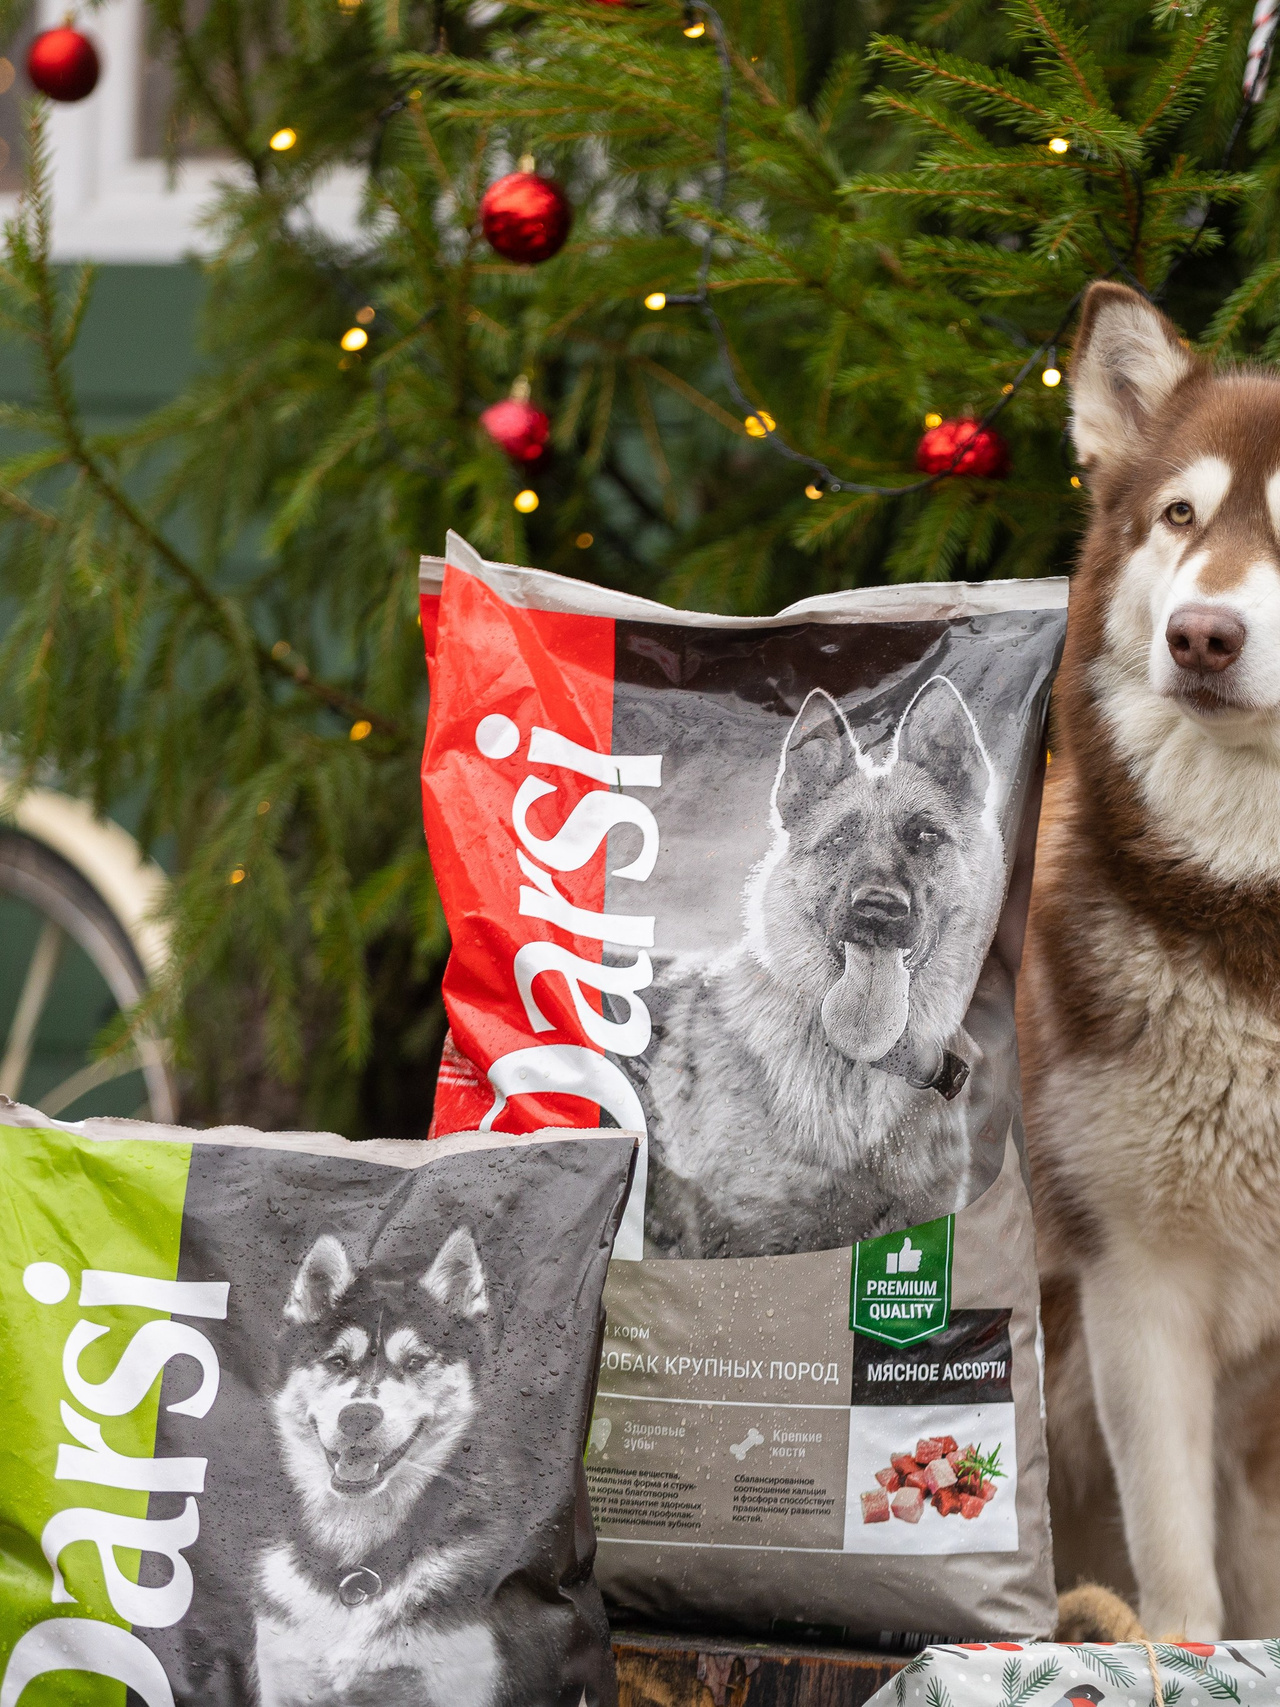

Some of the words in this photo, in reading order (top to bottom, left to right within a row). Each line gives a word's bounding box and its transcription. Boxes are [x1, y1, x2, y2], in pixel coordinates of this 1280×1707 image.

[867, 1280, 938, 1296] PREMIUM
[869, 1303, 934, 1321] QUALITY
[614, 1325, 650, 1341] корм
[664, 1356, 764, 1380] КРУПНЫХ
[769, 1361, 839, 1385] ПОРОД
[867, 1363, 940, 1382] МЯСНОЕ
[942, 1360, 1006, 1380] АССОРТИ
[623, 1420, 686, 1438] Здоровые
[773, 1429, 823, 1443] Крепкие
[623, 1437, 655, 1452] зубы
[772, 1444, 806, 1458] кости
[586, 1465, 637, 1476] инеральные
[639, 1471, 681, 1480] вещества,
[734, 1474, 815, 1485] Сбалансированное
[633, 1479, 661, 1488] форма
[733, 1485, 791, 1495] соотношение
[791, 1487, 827, 1496] кальция
[597, 1487, 624, 1495] корма
[625, 1487, 679, 1499] благотворно
[608, 1496, 619, 1504] на
[620, 1497, 660, 1507] развитие
[660, 1500, 702, 1510] здоровых
[740, 1494, 778, 1505] фосфора
[779, 1496, 835, 1507] способствует
[608, 1506, 648, 1517] являются
[649, 1509, 694, 1519] профилак-
[732, 1504, 790, 1516] правильному
[790, 1506, 831, 1516] развитию
[600, 1516, 666, 1527] возникновения
[667, 1519, 702, 1529] зубного
[731, 1514, 763, 1522] костей.
